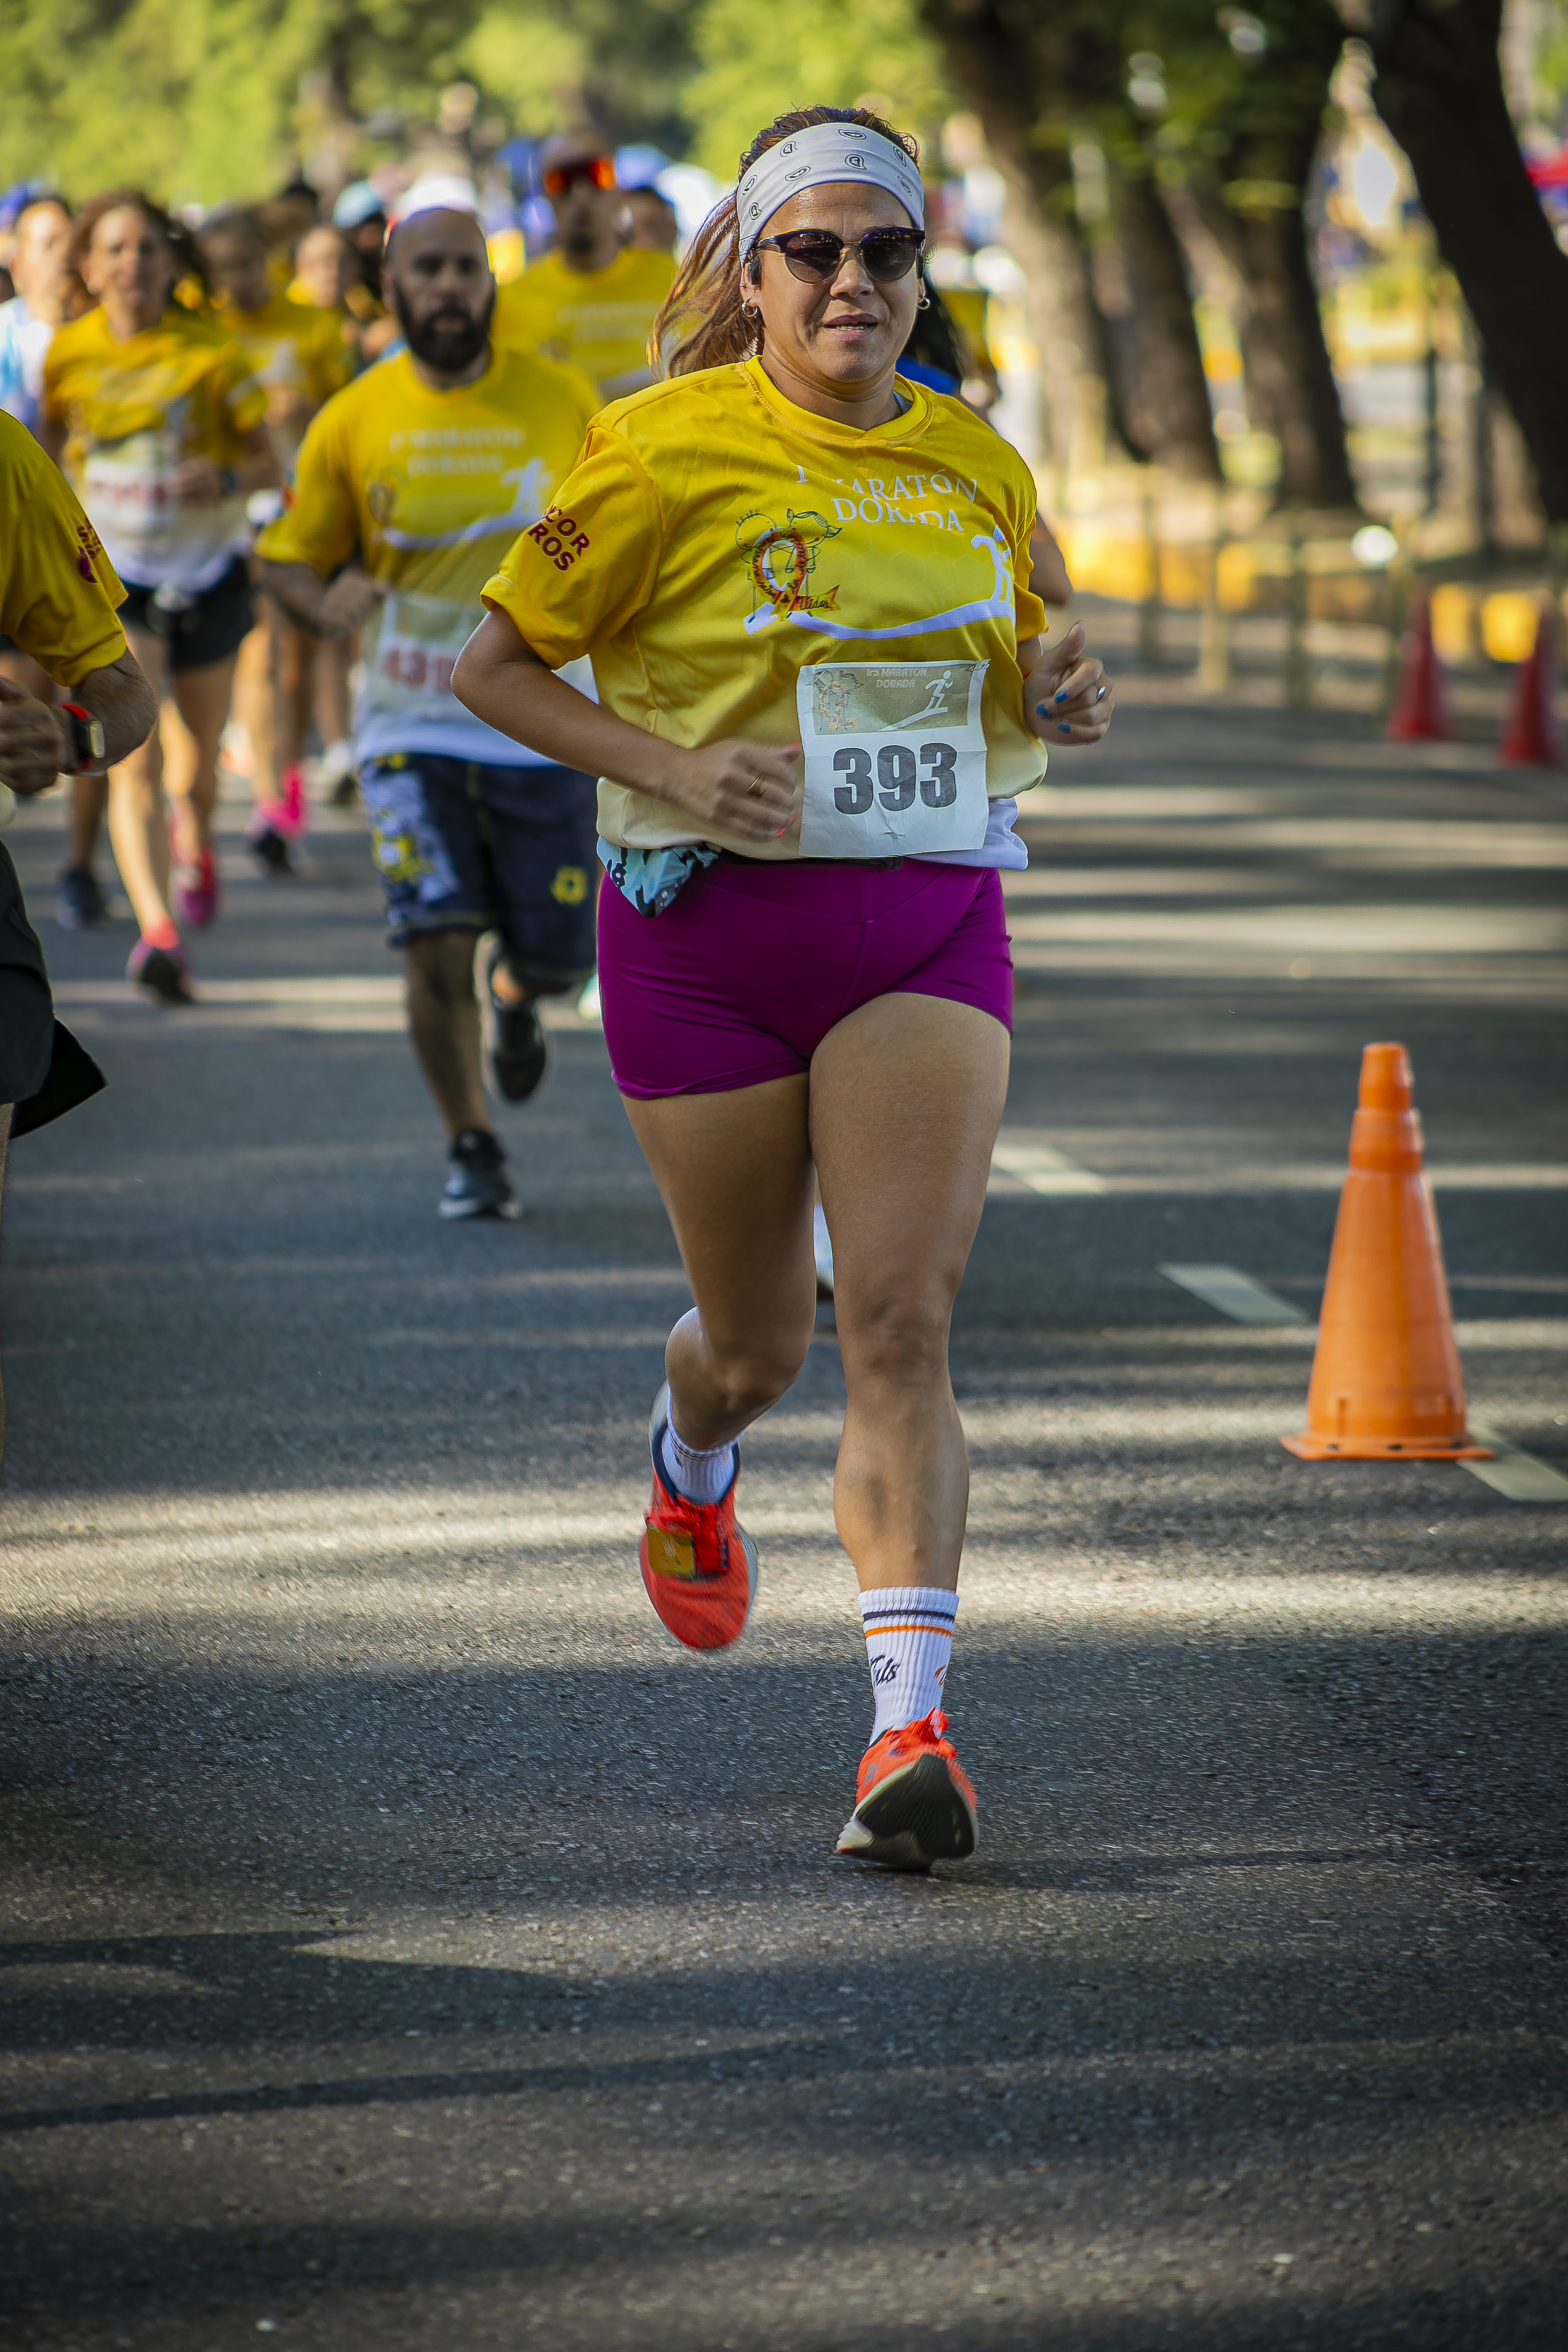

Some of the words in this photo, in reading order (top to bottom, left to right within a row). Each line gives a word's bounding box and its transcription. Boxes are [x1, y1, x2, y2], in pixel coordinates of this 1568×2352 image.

[836, 469, 977, 503] ARATÓN
[527, 522, 575, 571] ROS
[876, 679, 916, 689] DORADA
[833, 742, 957, 815] 393
